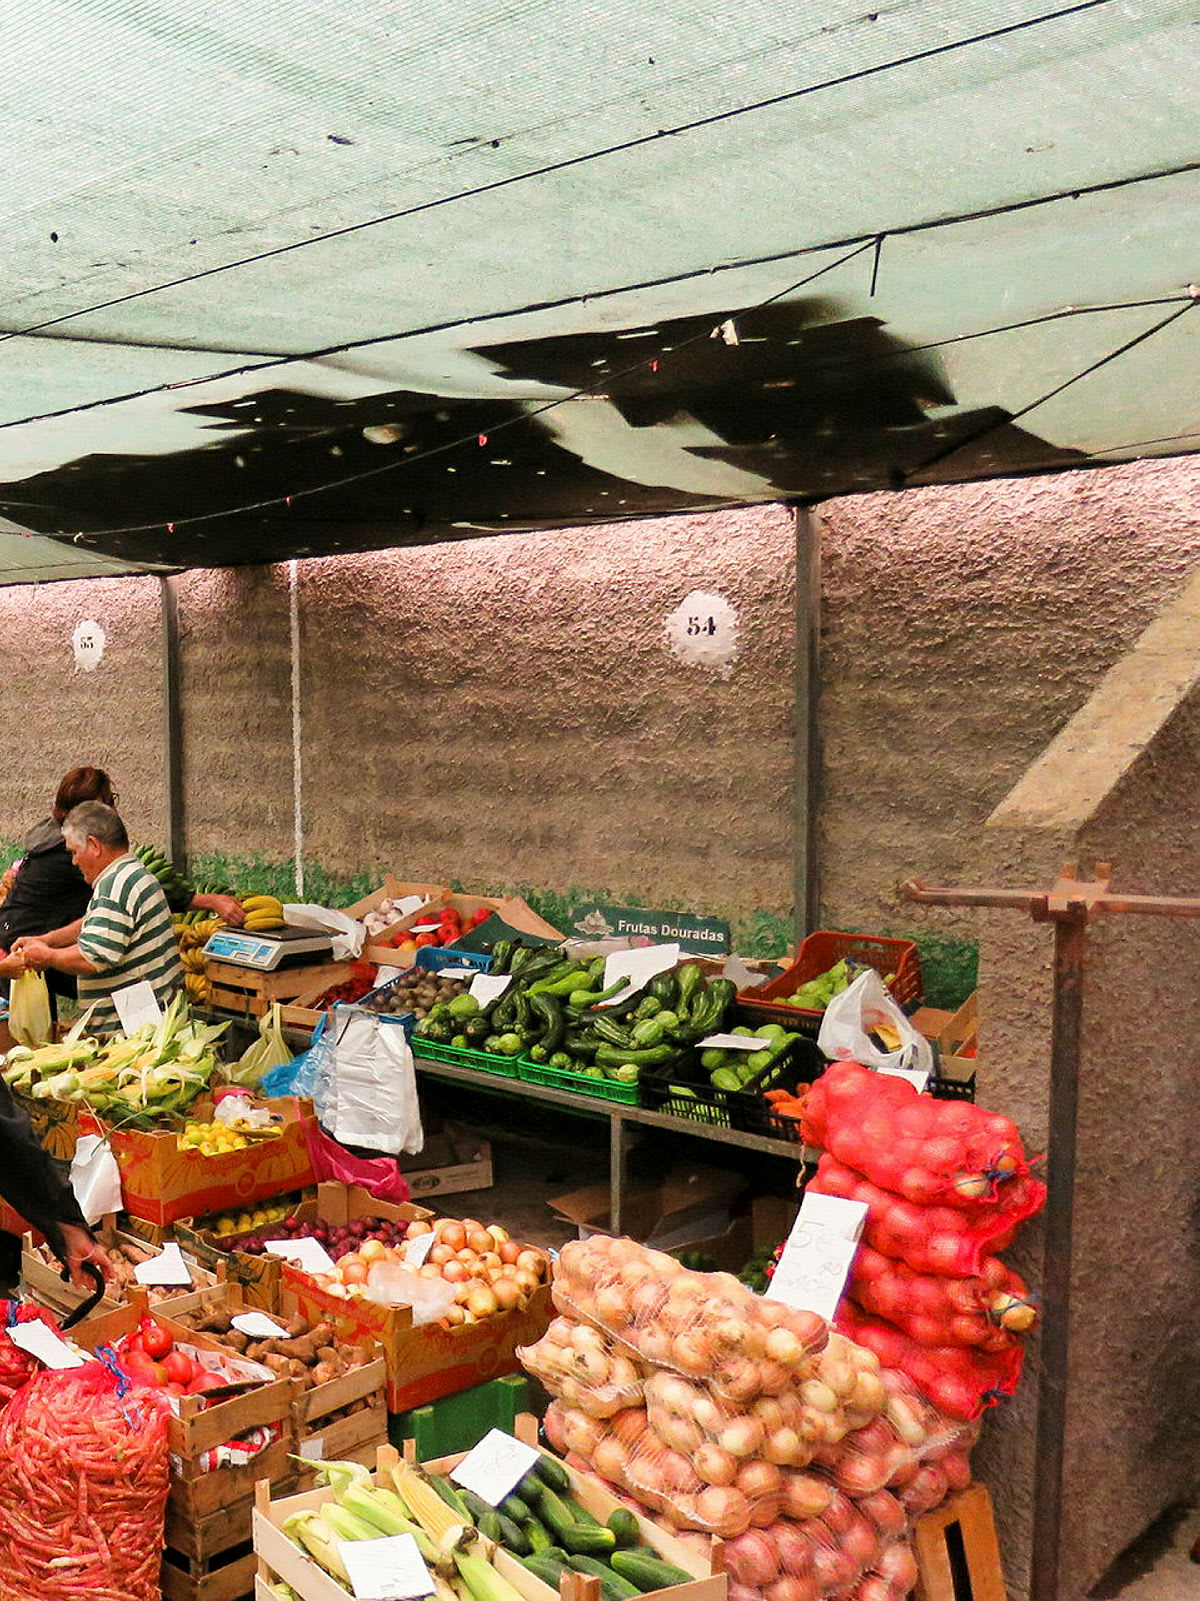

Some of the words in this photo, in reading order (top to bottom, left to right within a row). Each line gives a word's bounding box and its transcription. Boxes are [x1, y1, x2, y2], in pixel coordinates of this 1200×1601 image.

[687, 615, 717, 636] 54
[617, 919, 658, 936] Frutas
[660, 924, 725, 943] Douradas
